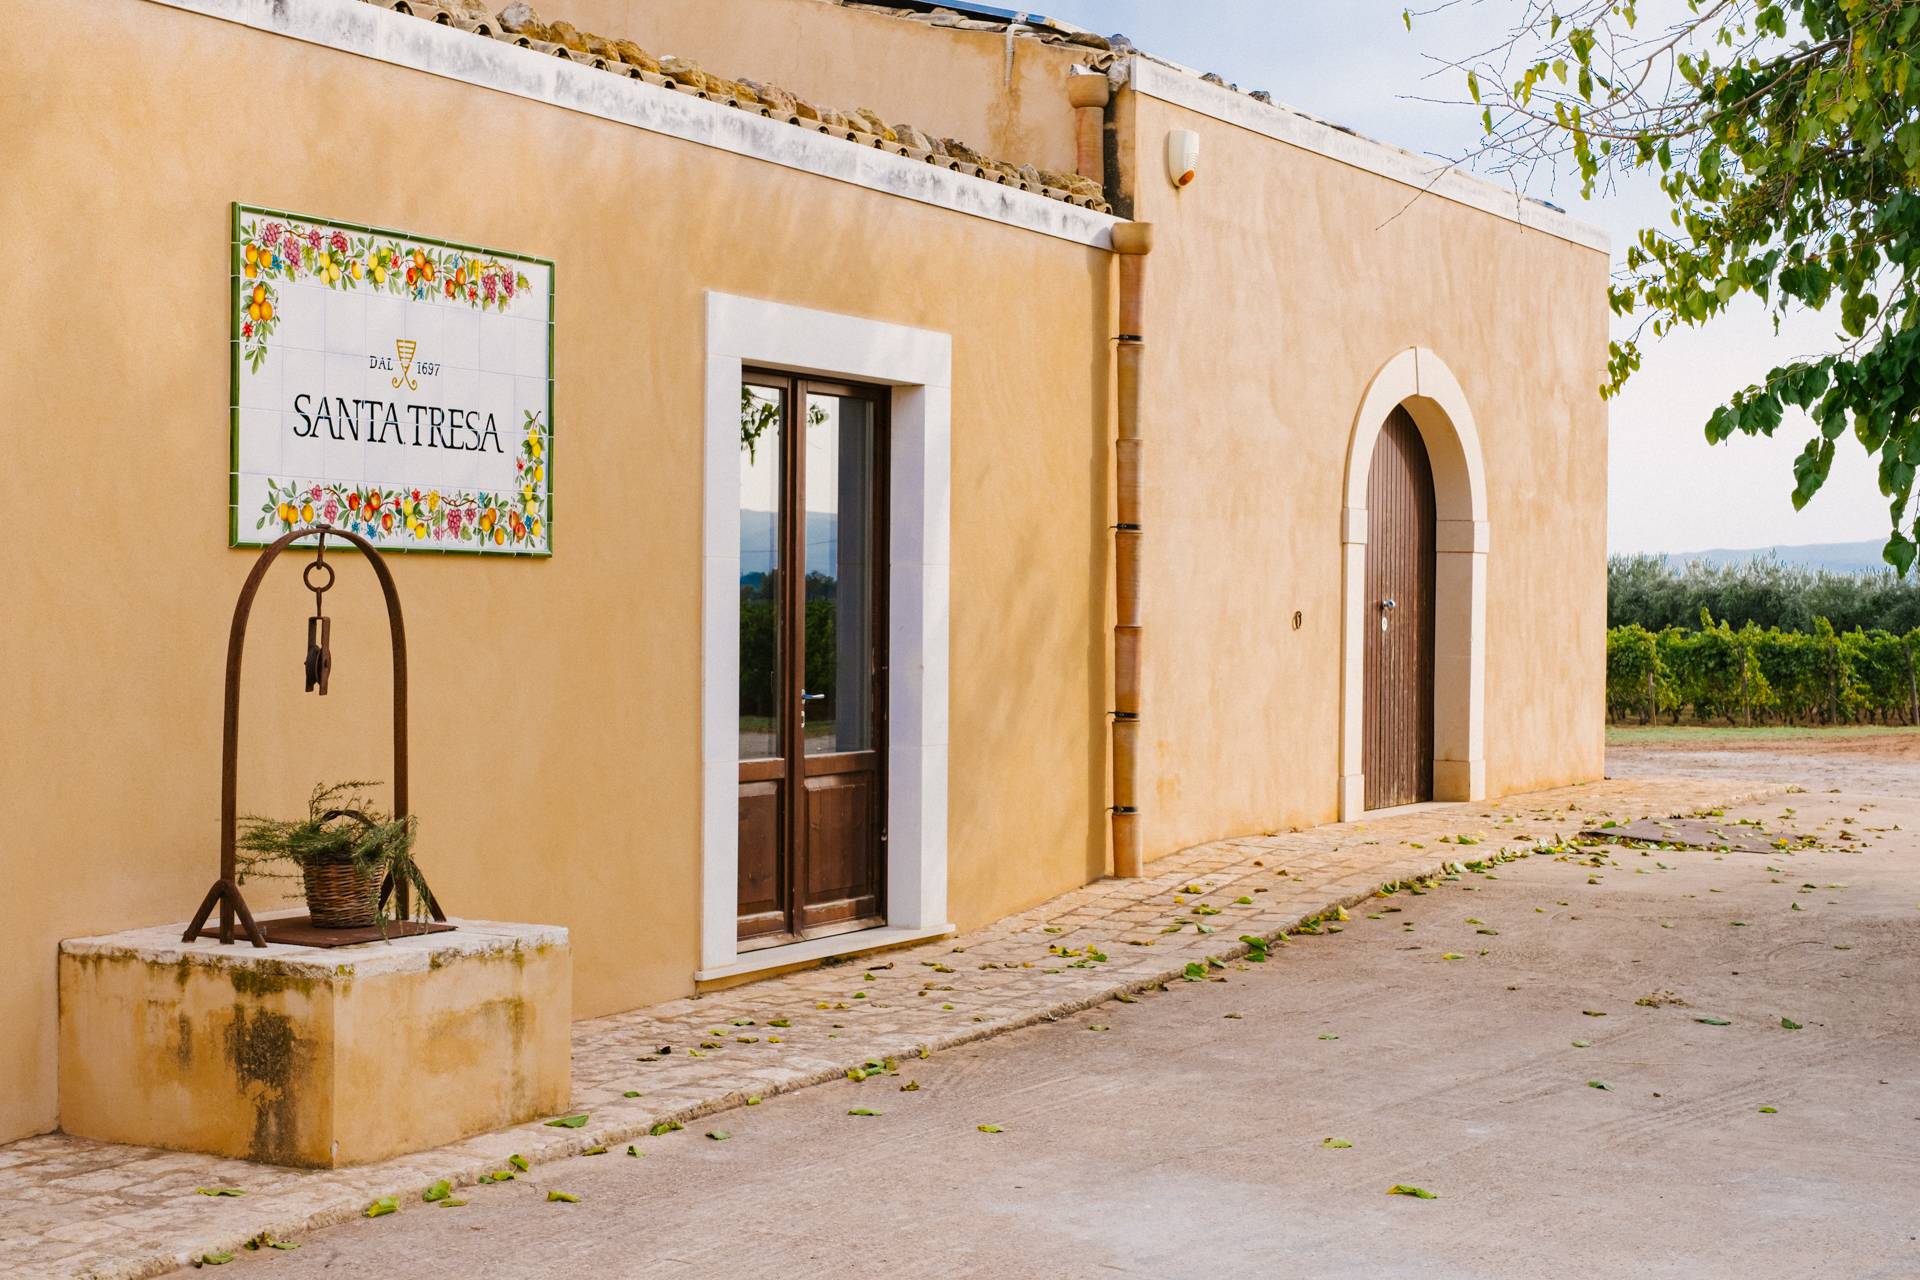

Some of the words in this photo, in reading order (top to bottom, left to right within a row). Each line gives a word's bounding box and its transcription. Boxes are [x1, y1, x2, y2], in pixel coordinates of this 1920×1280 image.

[369, 355, 393, 371] DAL
[417, 362, 441, 377] 1697
[293, 393, 406, 445] SANTA
[407, 404, 504, 453] TRESA
